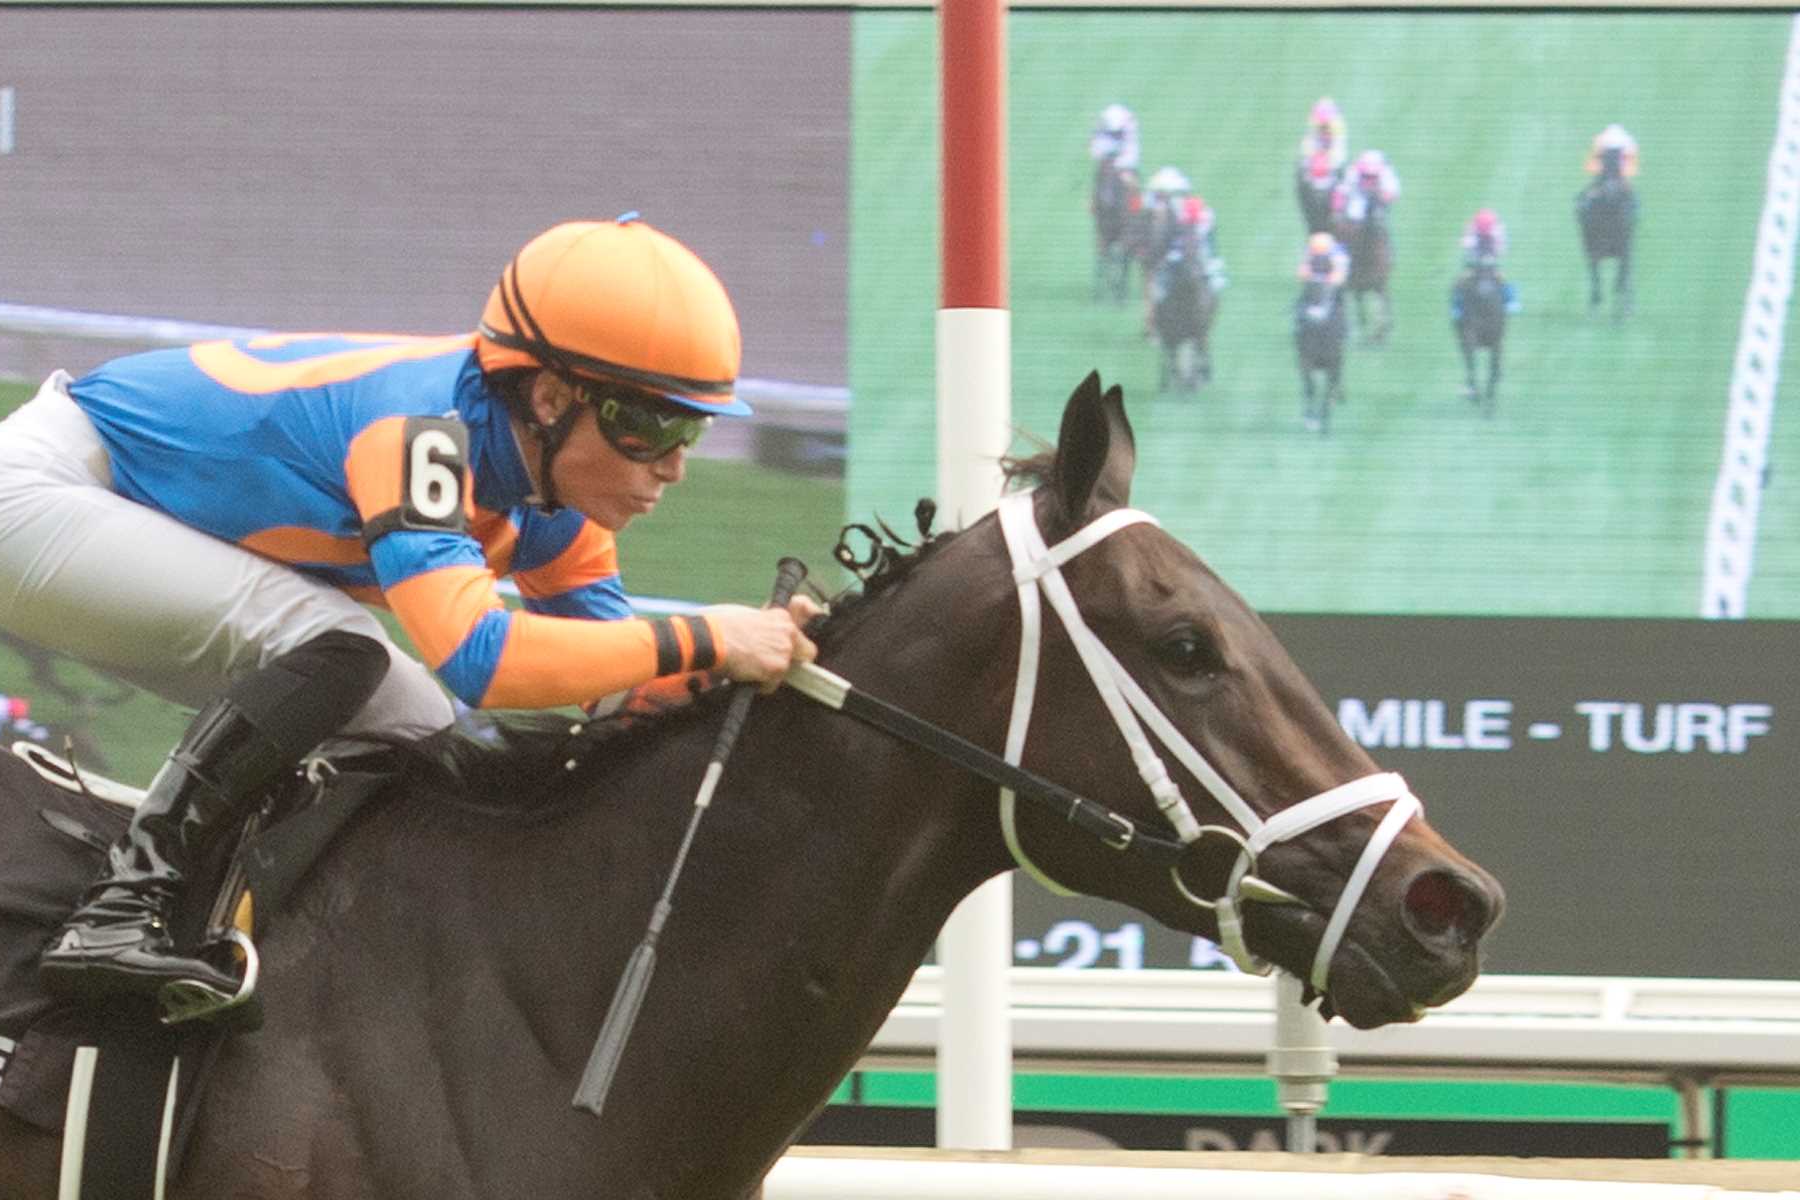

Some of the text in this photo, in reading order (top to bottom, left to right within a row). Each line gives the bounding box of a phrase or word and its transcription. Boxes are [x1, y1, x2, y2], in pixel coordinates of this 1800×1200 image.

[410, 429, 460, 520] 6
[1341, 699, 1511, 750] MILE
[1576, 702, 1774, 754] TURF
